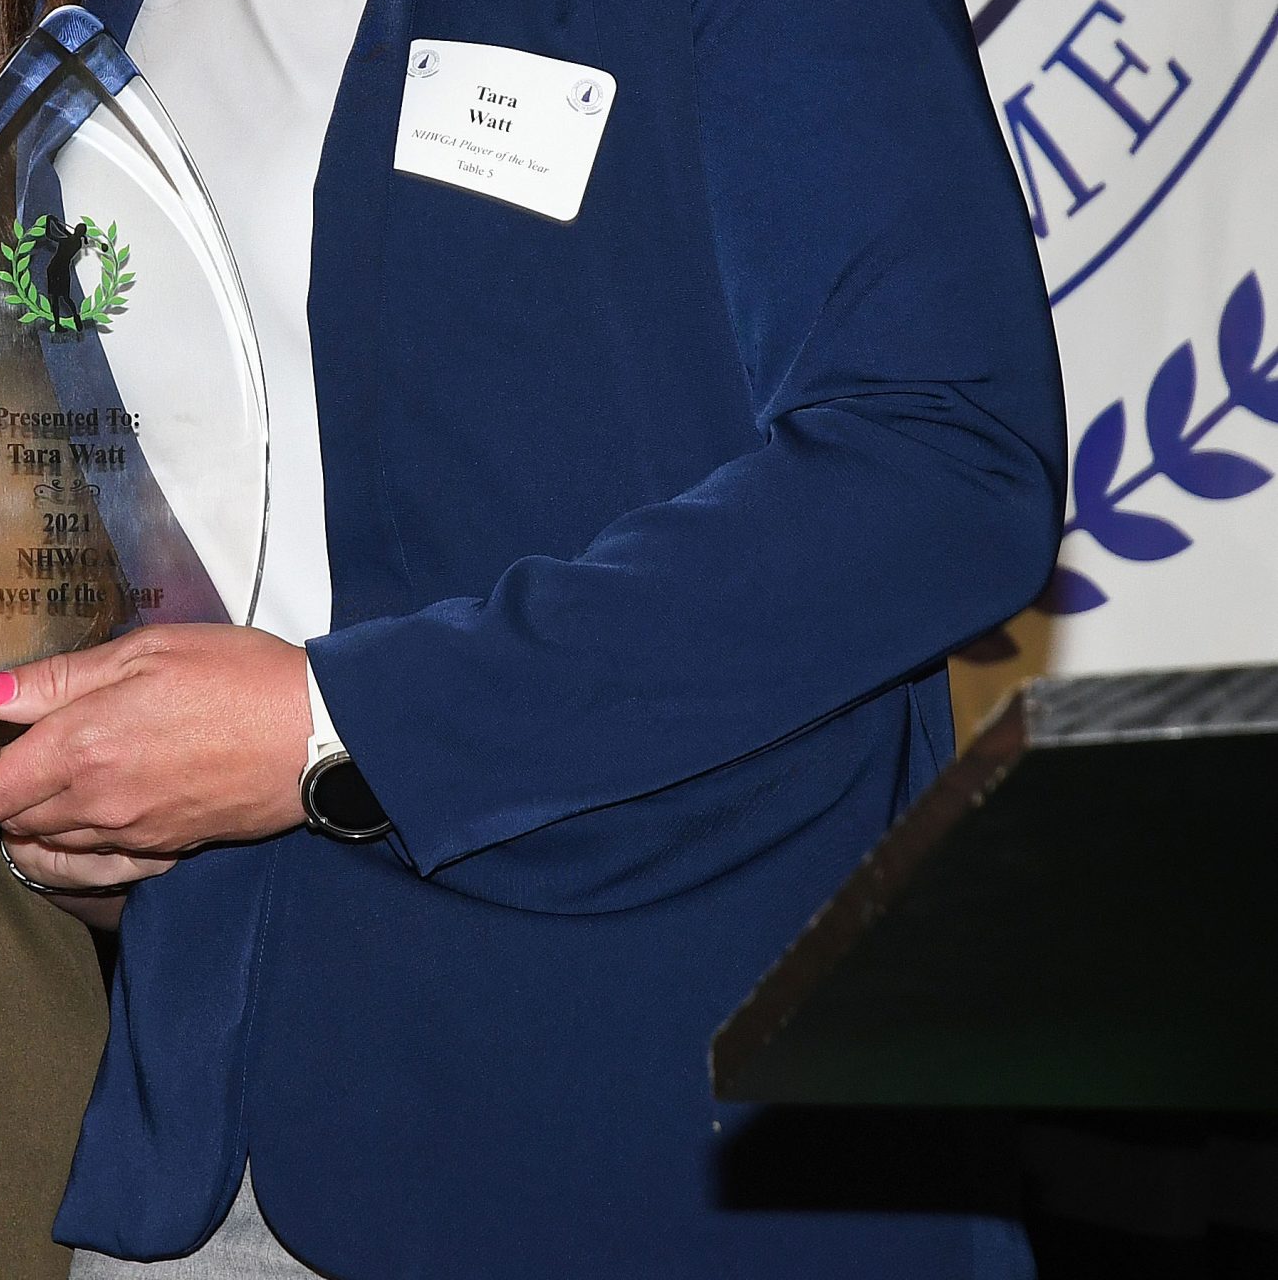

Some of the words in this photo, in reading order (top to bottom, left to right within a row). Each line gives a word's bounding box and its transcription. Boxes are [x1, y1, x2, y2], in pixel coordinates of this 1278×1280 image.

[476, 85, 518, 109] Tara
[469, 108, 513, 133] Watt
[411, 128, 457, 148] NHWGA
[459, 138, 494, 156] Player
[495, 150, 510, 162] of
[508, 154, 525, 167] the
[527, 158, 550, 174] Year
[457, 159, 485, 176] Table
[486, 168, 495, 179] 5
[106, 407, 140, 428] To:
[7, 443, 62, 465] Tara
[68, 443, 126, 465] Watt
[42, 513, 90, 533] 2021
[17, 547, 118, 567] NHWGA
[46, 583, 70, 602] of
[74, 583, 107, 602] the
